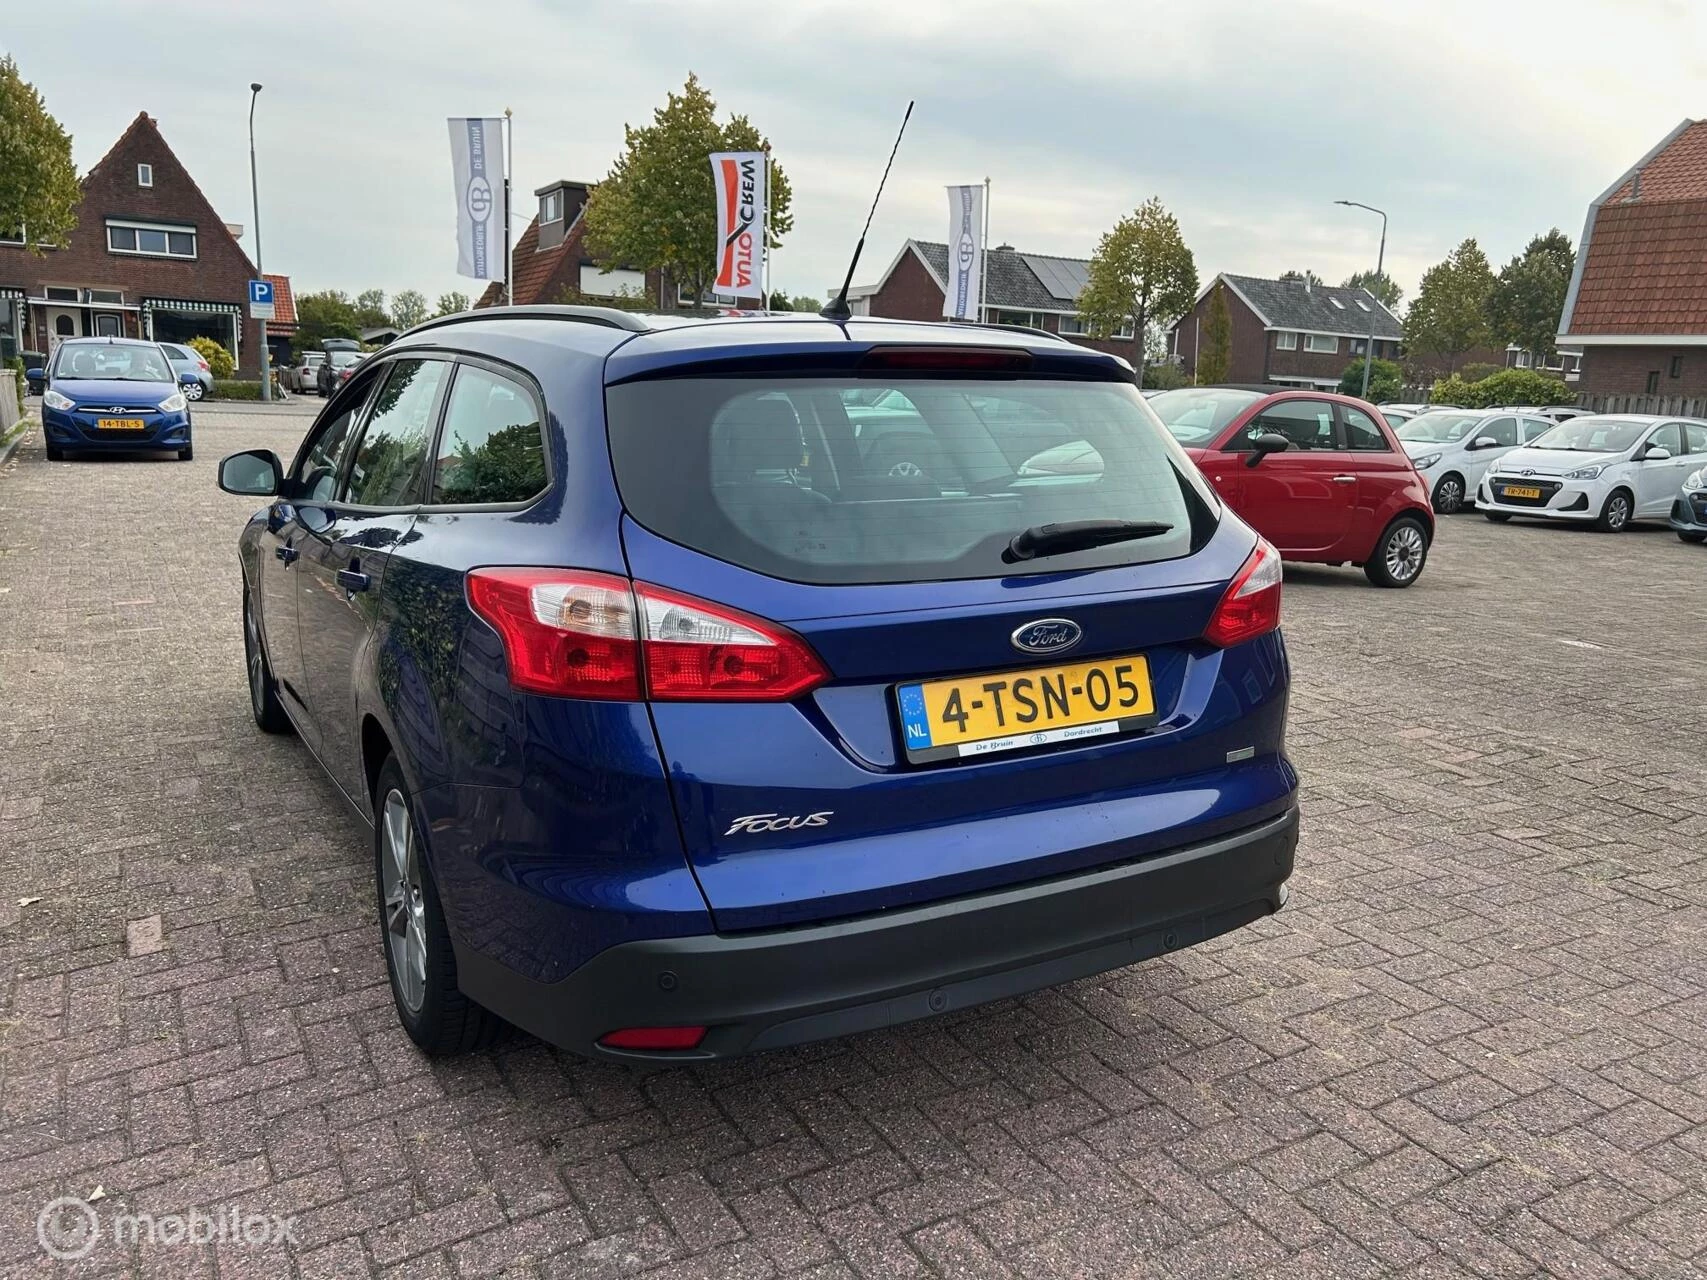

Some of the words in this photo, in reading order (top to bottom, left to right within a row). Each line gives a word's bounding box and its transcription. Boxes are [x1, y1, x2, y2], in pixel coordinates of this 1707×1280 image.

[255, 284, 268, 300] P
[102, 420, 140, 428] 14-TBL-S
[1029, 625, 1068, 646] Ford
[942, 665, 1139, 733] 4-TSN-05
[908, 723, 927, 738] NL
[990, 740, 1014, 750] Bruin
[1064, 726, 1103, 738] Dordrecht
